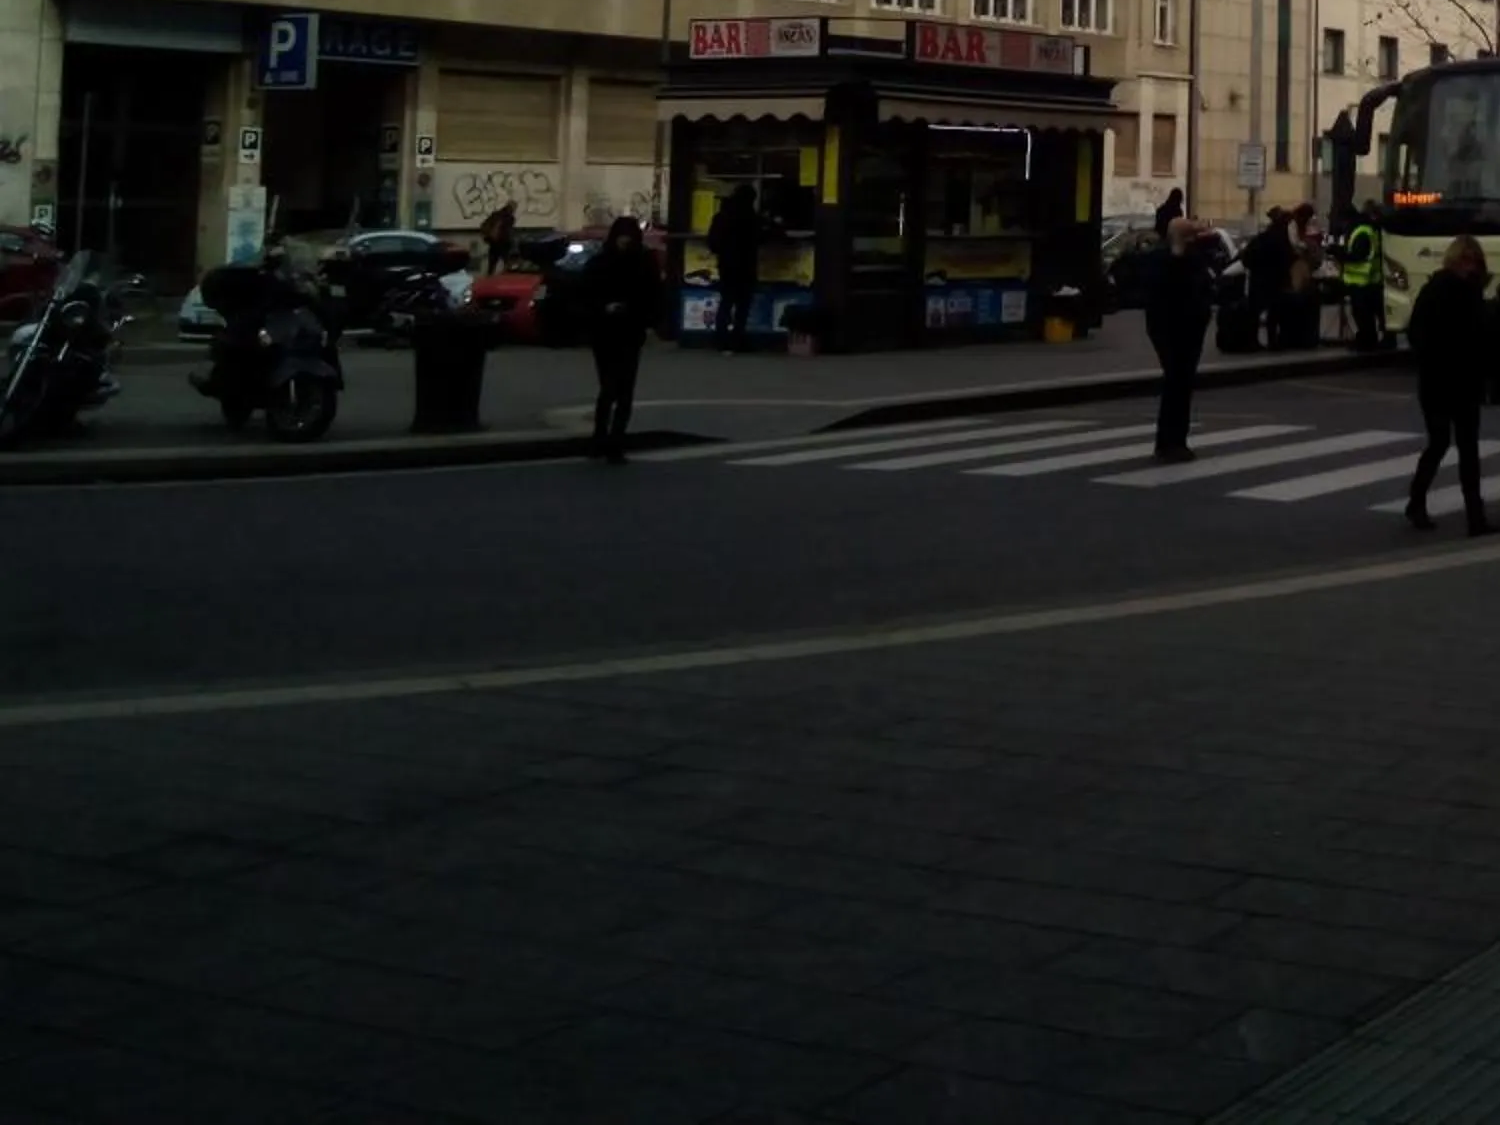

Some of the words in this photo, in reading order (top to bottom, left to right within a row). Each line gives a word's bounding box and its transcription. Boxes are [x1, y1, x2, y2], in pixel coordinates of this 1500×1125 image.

[268, 20, 297, 69] P
[322, 25, 418, 58] RAGE
[693, 24, 742, 56] BAR
[919, 24, 987, 64] BAR
